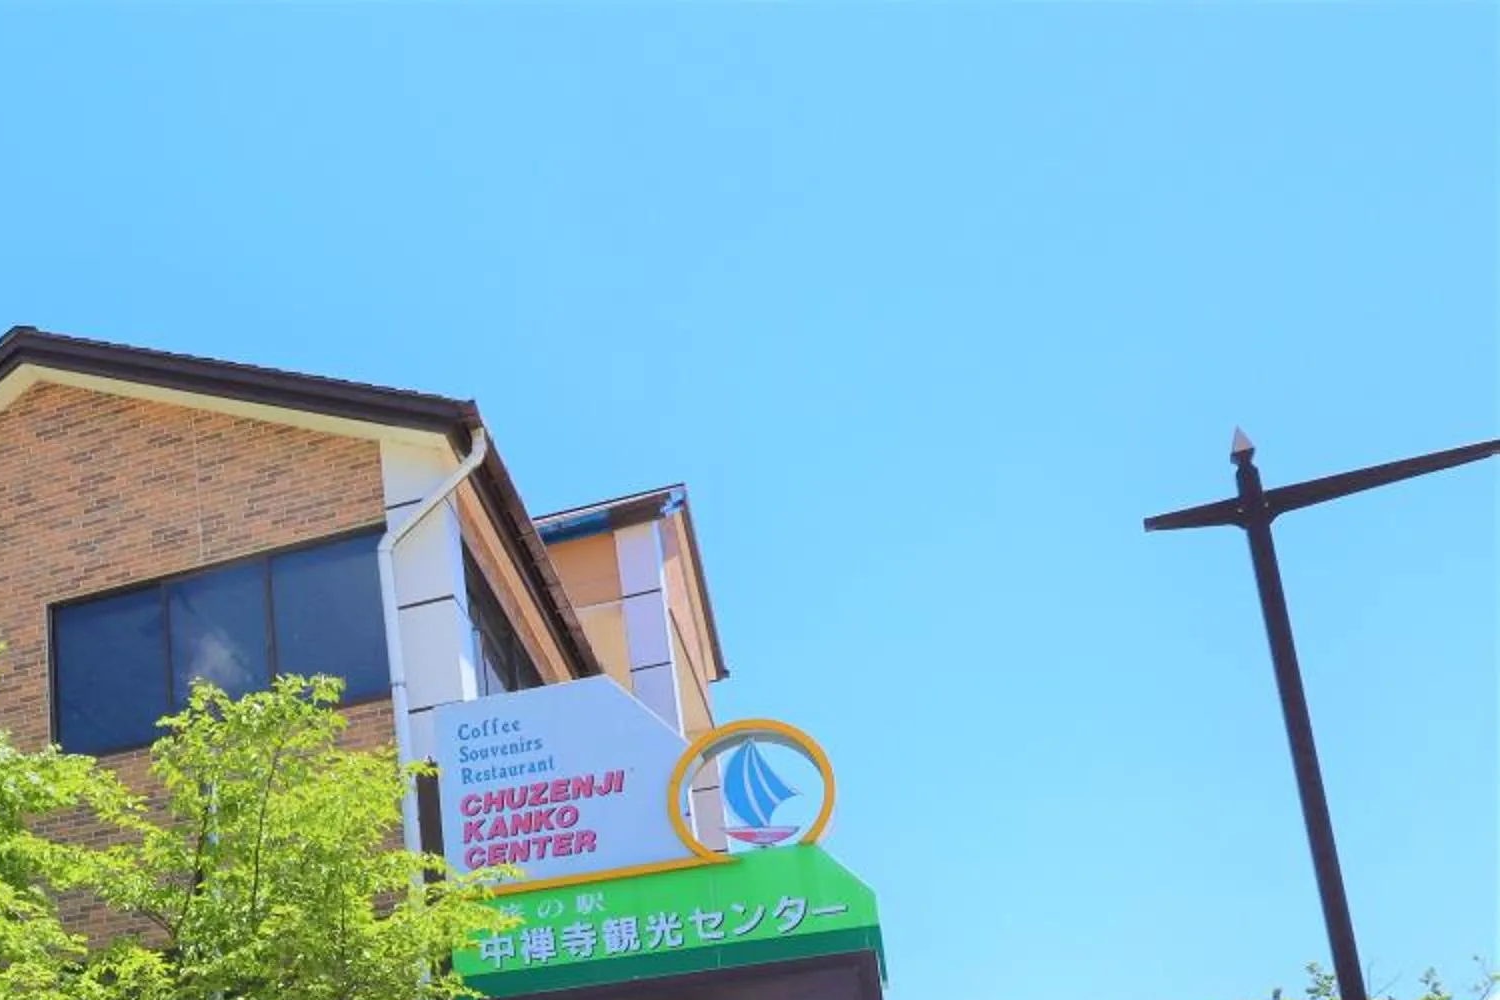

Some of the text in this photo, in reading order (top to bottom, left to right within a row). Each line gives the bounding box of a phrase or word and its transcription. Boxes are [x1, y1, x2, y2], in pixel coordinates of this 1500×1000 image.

[457, 718, 521, 741] Coffee
[459, 737, 543, 763] Souvenirs
[461, 755, 555, 785] Restaurant
[460, 769, 625, 817] CHUZENJI
[463, 805, 579, 844] KANKO
[465, 829, 597, 870] CENTER
[481, 896, 849, 968] 中禅寺観光センター
